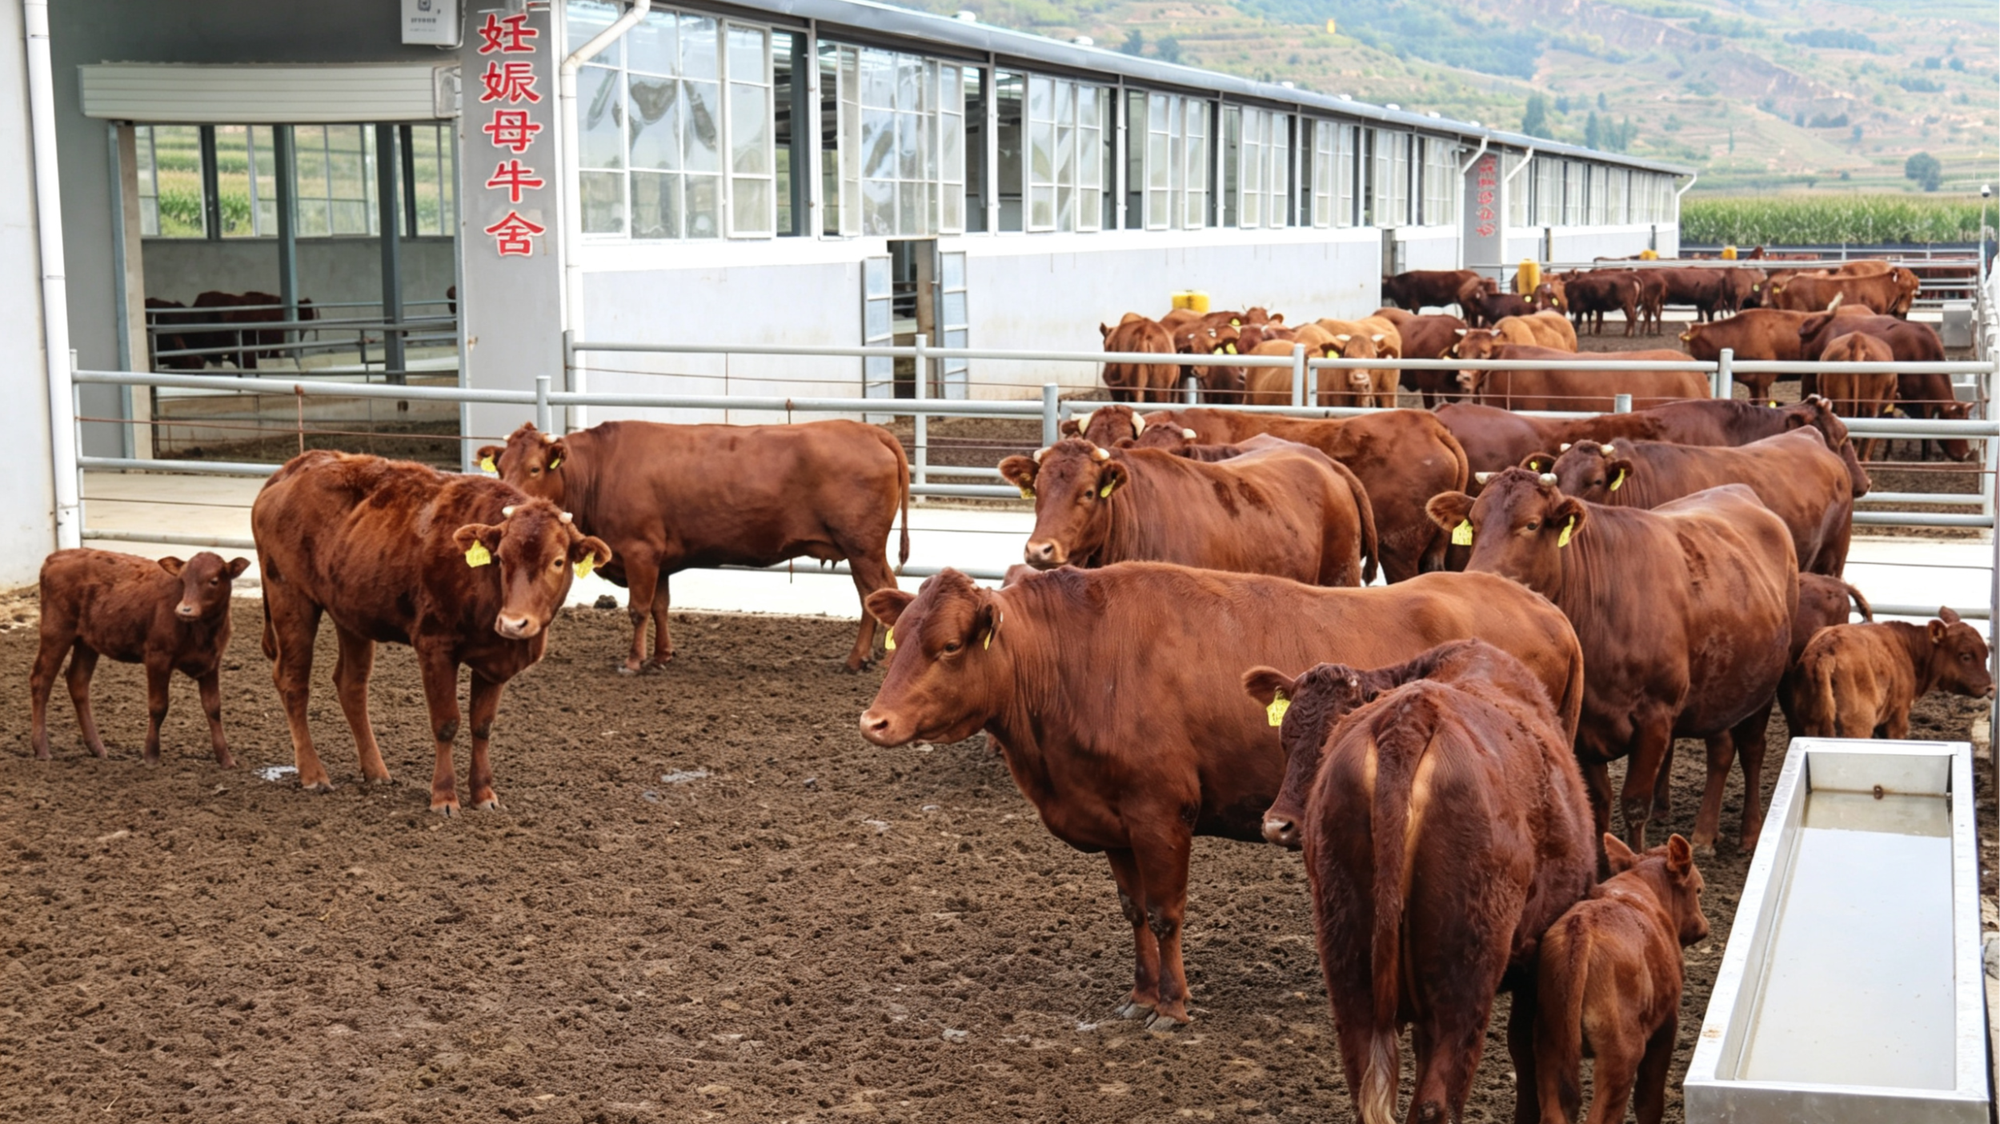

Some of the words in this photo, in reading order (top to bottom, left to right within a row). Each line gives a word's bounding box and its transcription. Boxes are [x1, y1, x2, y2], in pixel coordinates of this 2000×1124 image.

[478, 13, 546, 257] 妊娠母牛舍
